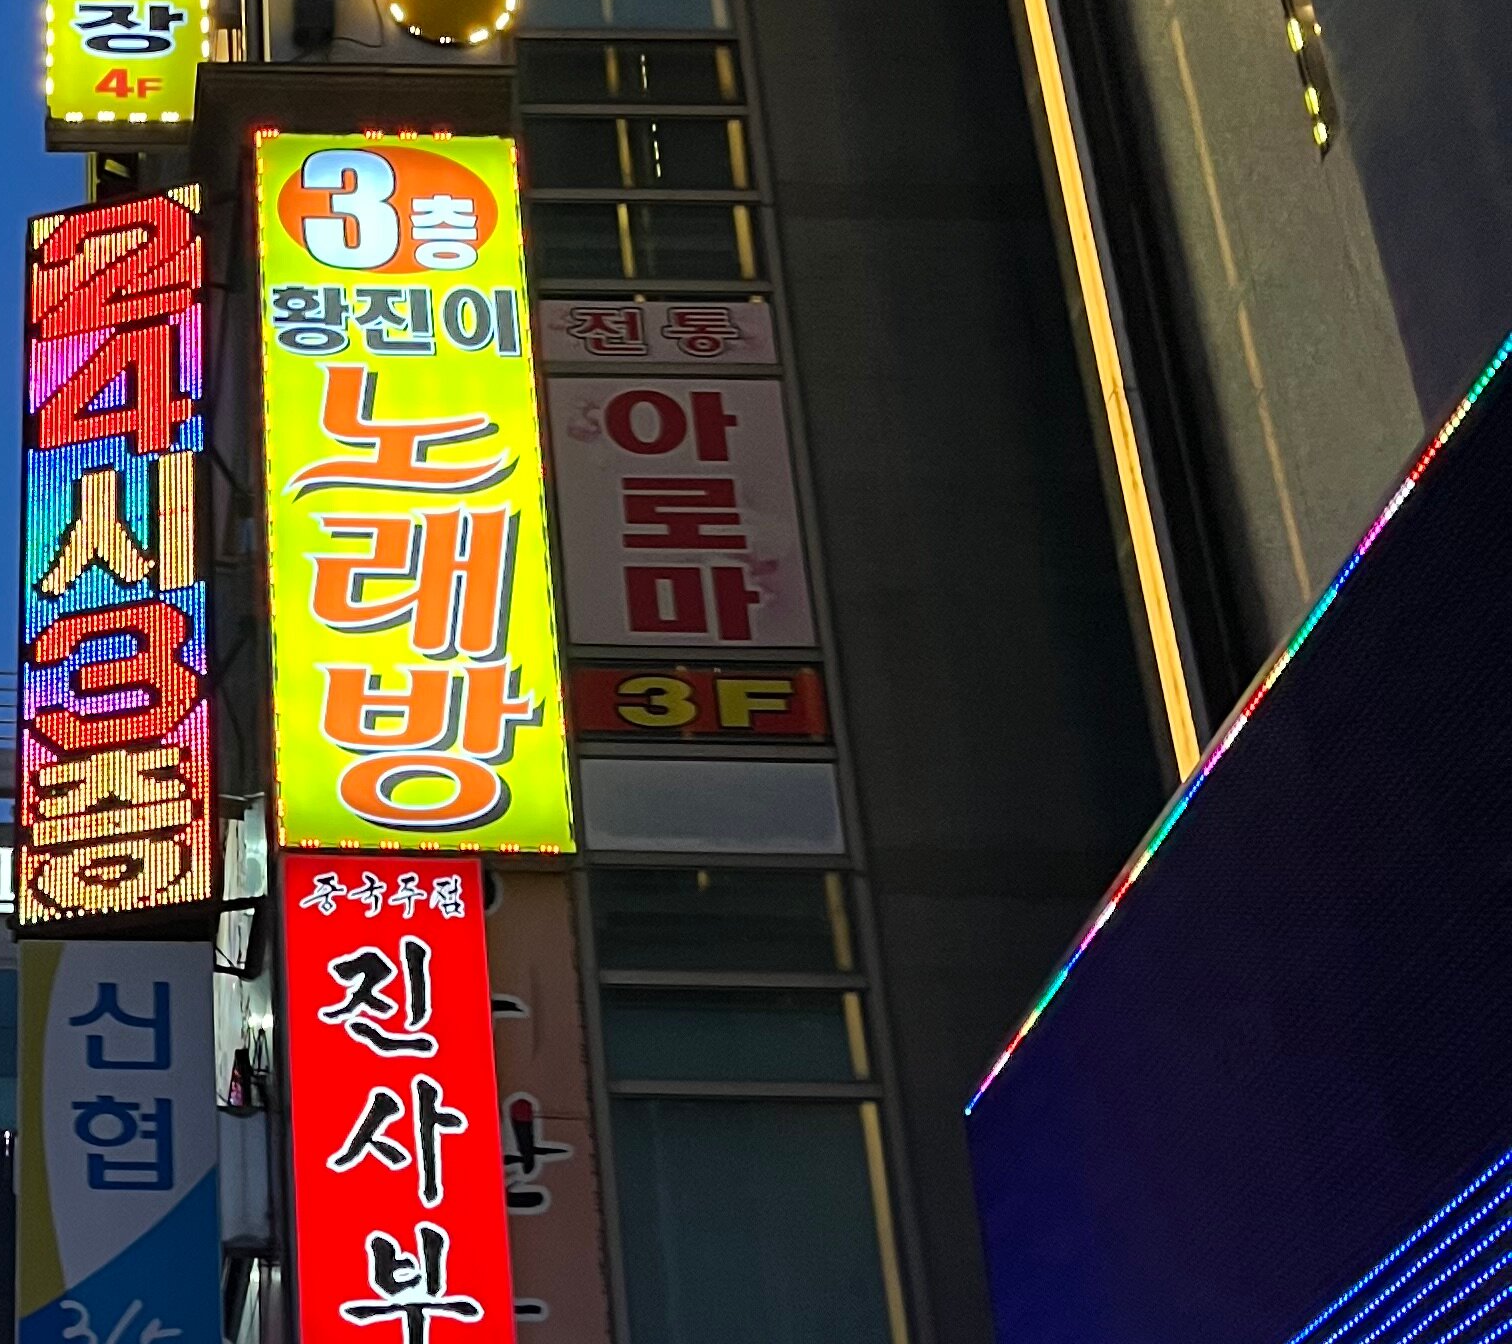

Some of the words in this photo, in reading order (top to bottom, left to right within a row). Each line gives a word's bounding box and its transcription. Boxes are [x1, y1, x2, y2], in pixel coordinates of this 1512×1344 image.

[94, 67, 164, 101] 4F
[299, 148, 481, 272] 3층
[270, 283, 522, 359] 황진이
[567, 306, 741, 356] 전통
[604, 389, 761, 641] 아로마
[285, 363, 546, 833] 노래방
[617, 674, 793, 730] 3F
[299, 870, 466, 920] 중국주점
[68, 981, 176, 1192] 신협
